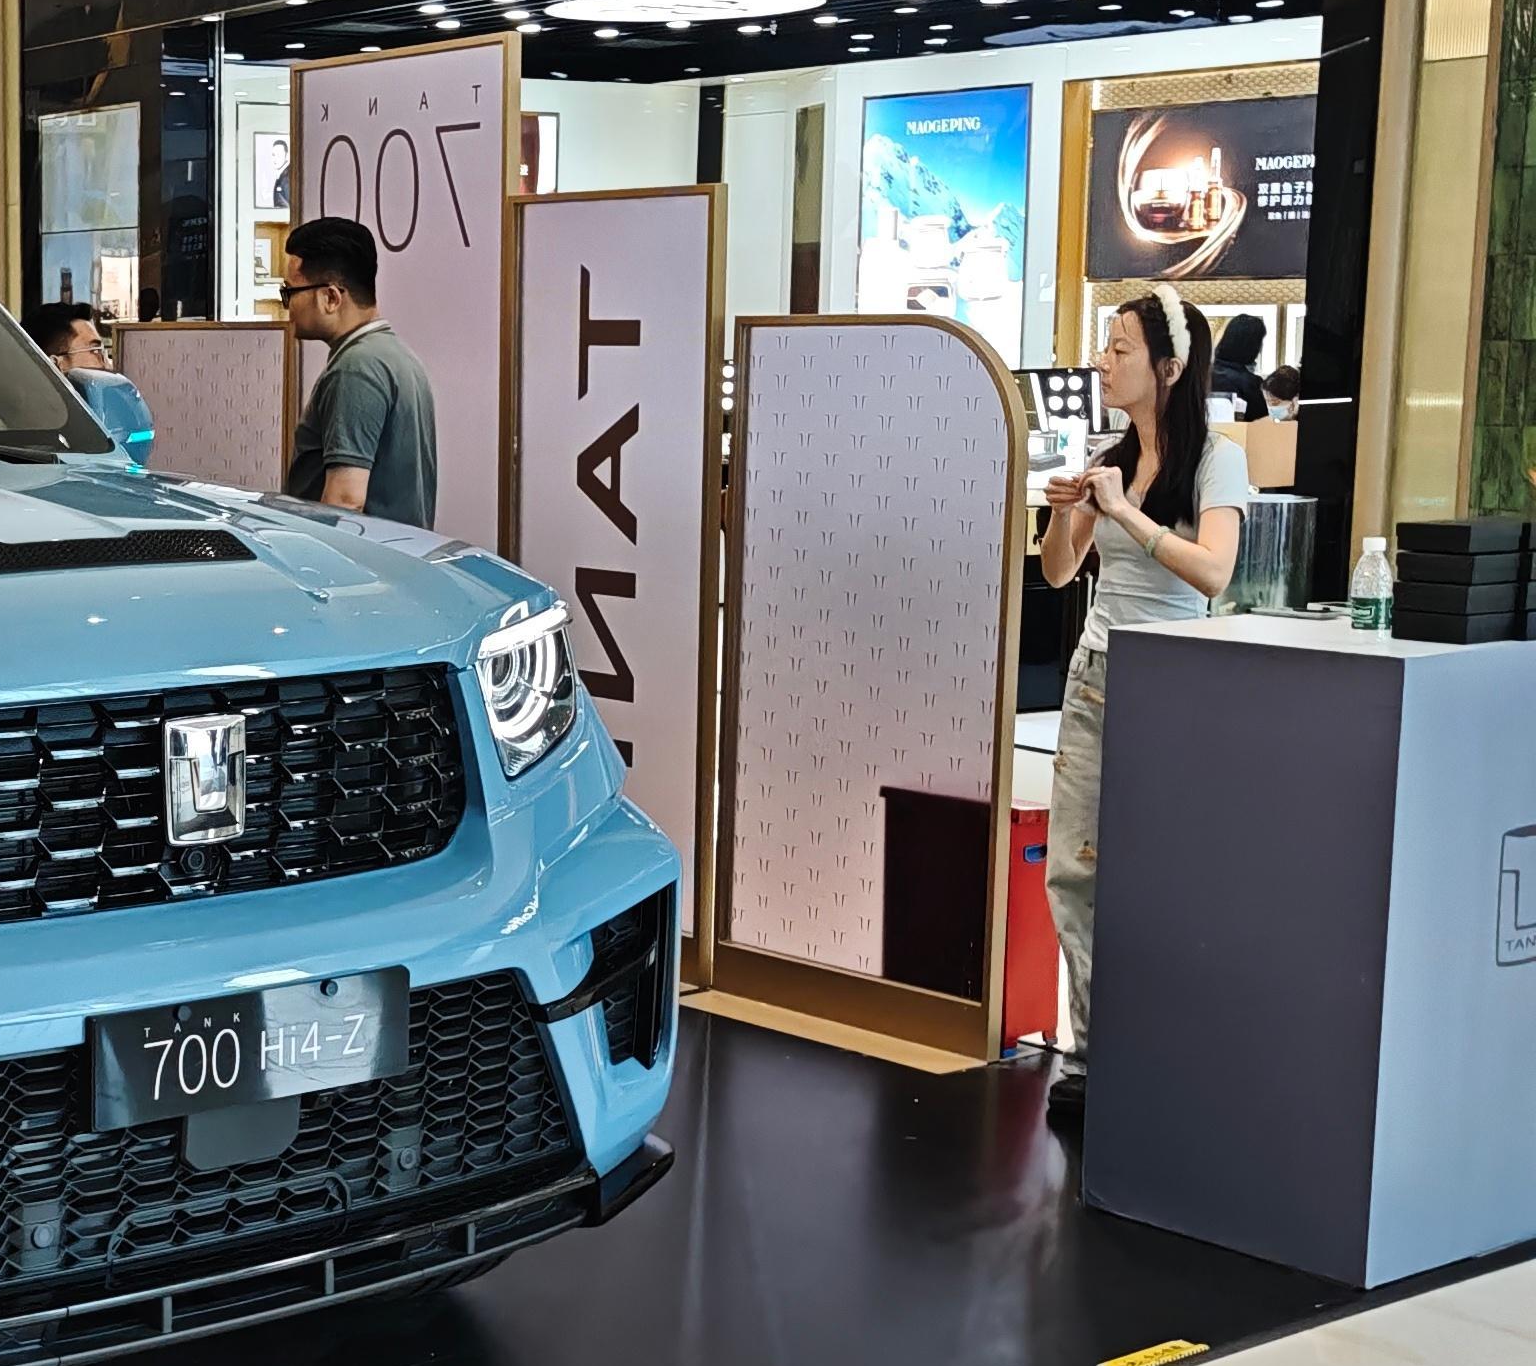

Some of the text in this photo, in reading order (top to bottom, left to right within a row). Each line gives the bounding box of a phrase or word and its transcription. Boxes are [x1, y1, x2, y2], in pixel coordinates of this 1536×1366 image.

[906, 116, 981, 135] MAOGEPING
[144, 1012, 240, 1039] TANK
[144, 1014, 366, 1101] 700 Hi4-Z
